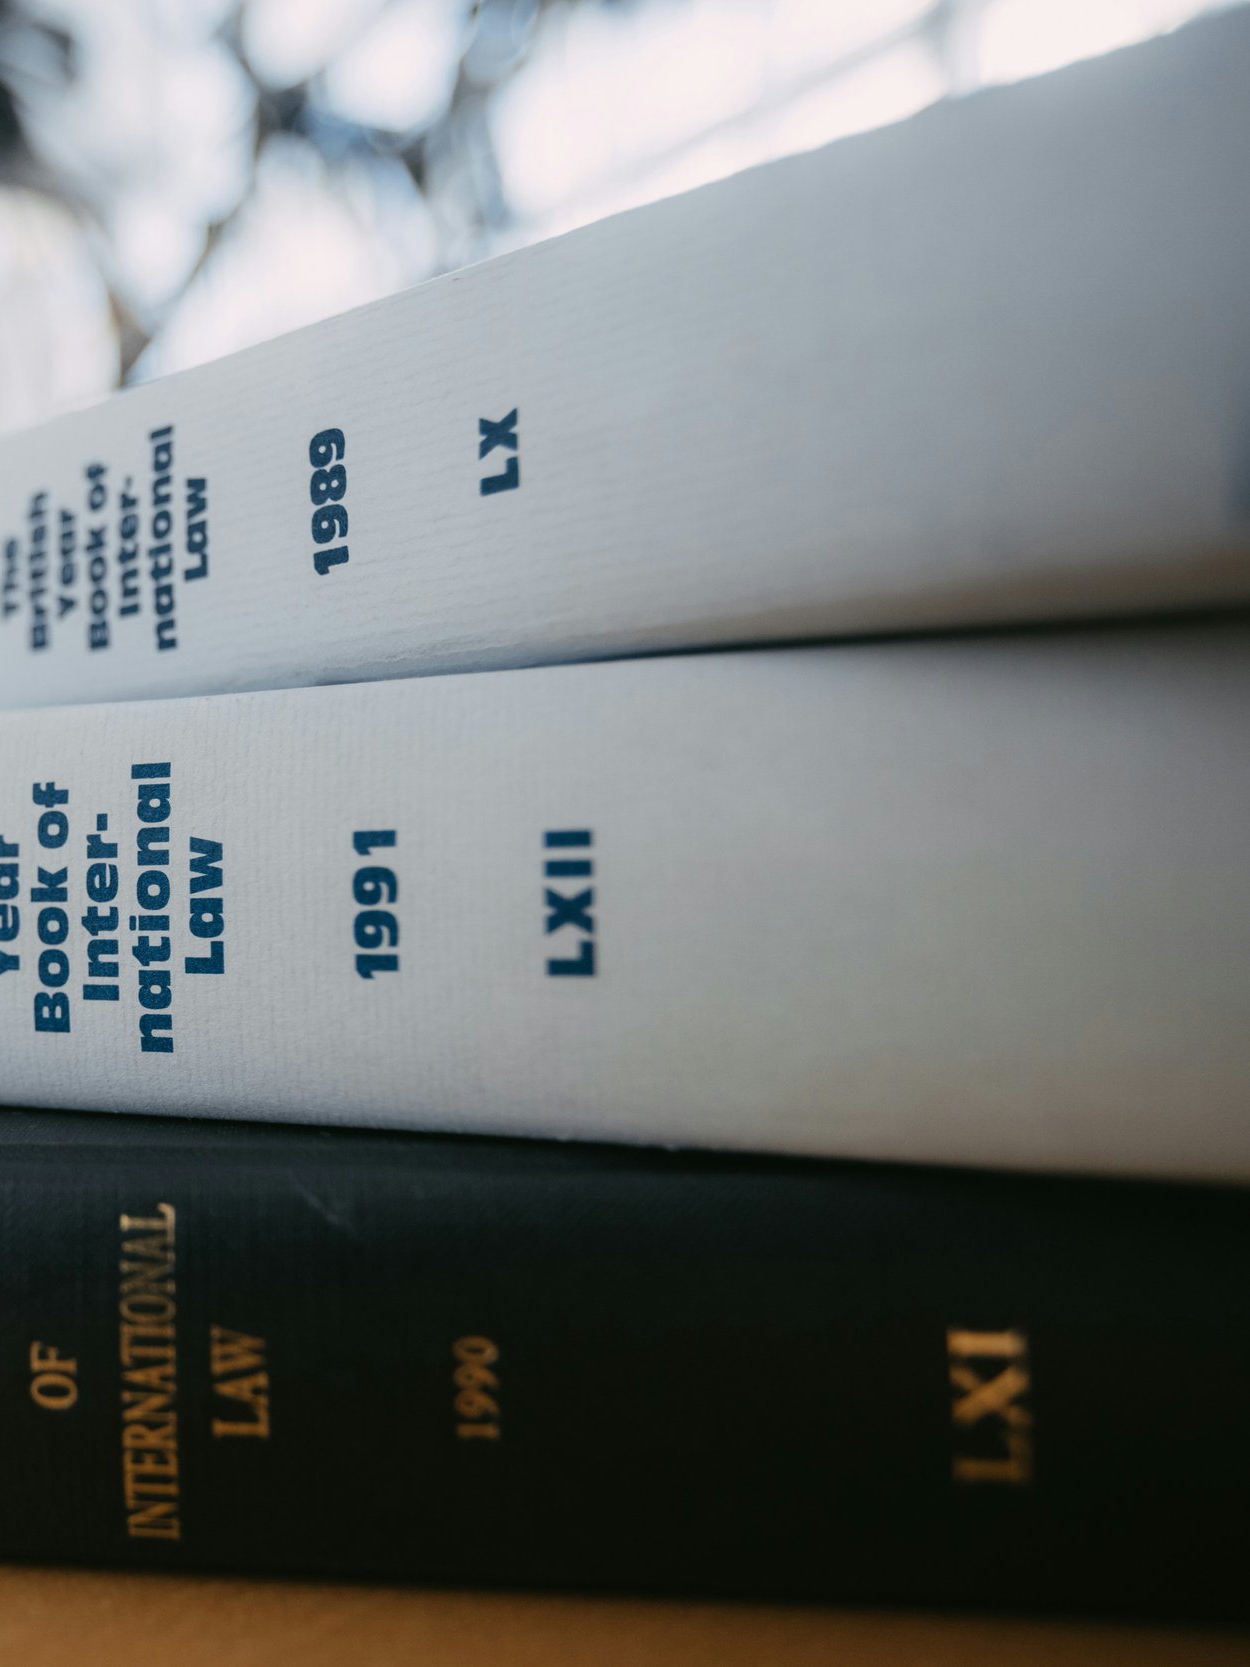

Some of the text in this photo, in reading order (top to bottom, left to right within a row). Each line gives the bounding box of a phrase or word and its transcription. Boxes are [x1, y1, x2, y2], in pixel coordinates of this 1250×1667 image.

[309, 428, 350, 576] 1989
[479, 408, 520, 497] LX
[1, 537, 20, 621] The
[29, 491, 49, 651] British
[58, 507, 76, 619] Year
[85, 462, 110, 650] Book of
[117, 476, 140, 617] Inter-
[148, 425, 178, 650] national
[184, 478, 209, 582] Law
[31, 782, 71, 1033] Book of
[81, 813, 120, 1001] Inter-
[130, 762, 174, 1053] national
[185, 836, 225, 974] Law
[353, 829, 399, 979] 1991
[543, 830, 596, 978] LXII
[30, 1341, 77, 1409] OF
[119, 1202, 181, 1540] INTERNATIONAL
[210, 1324, 269, 1438] LAW
[453, 1335, 500, 1439] 1990
[949, 1330, 1031, 1483] LXI
